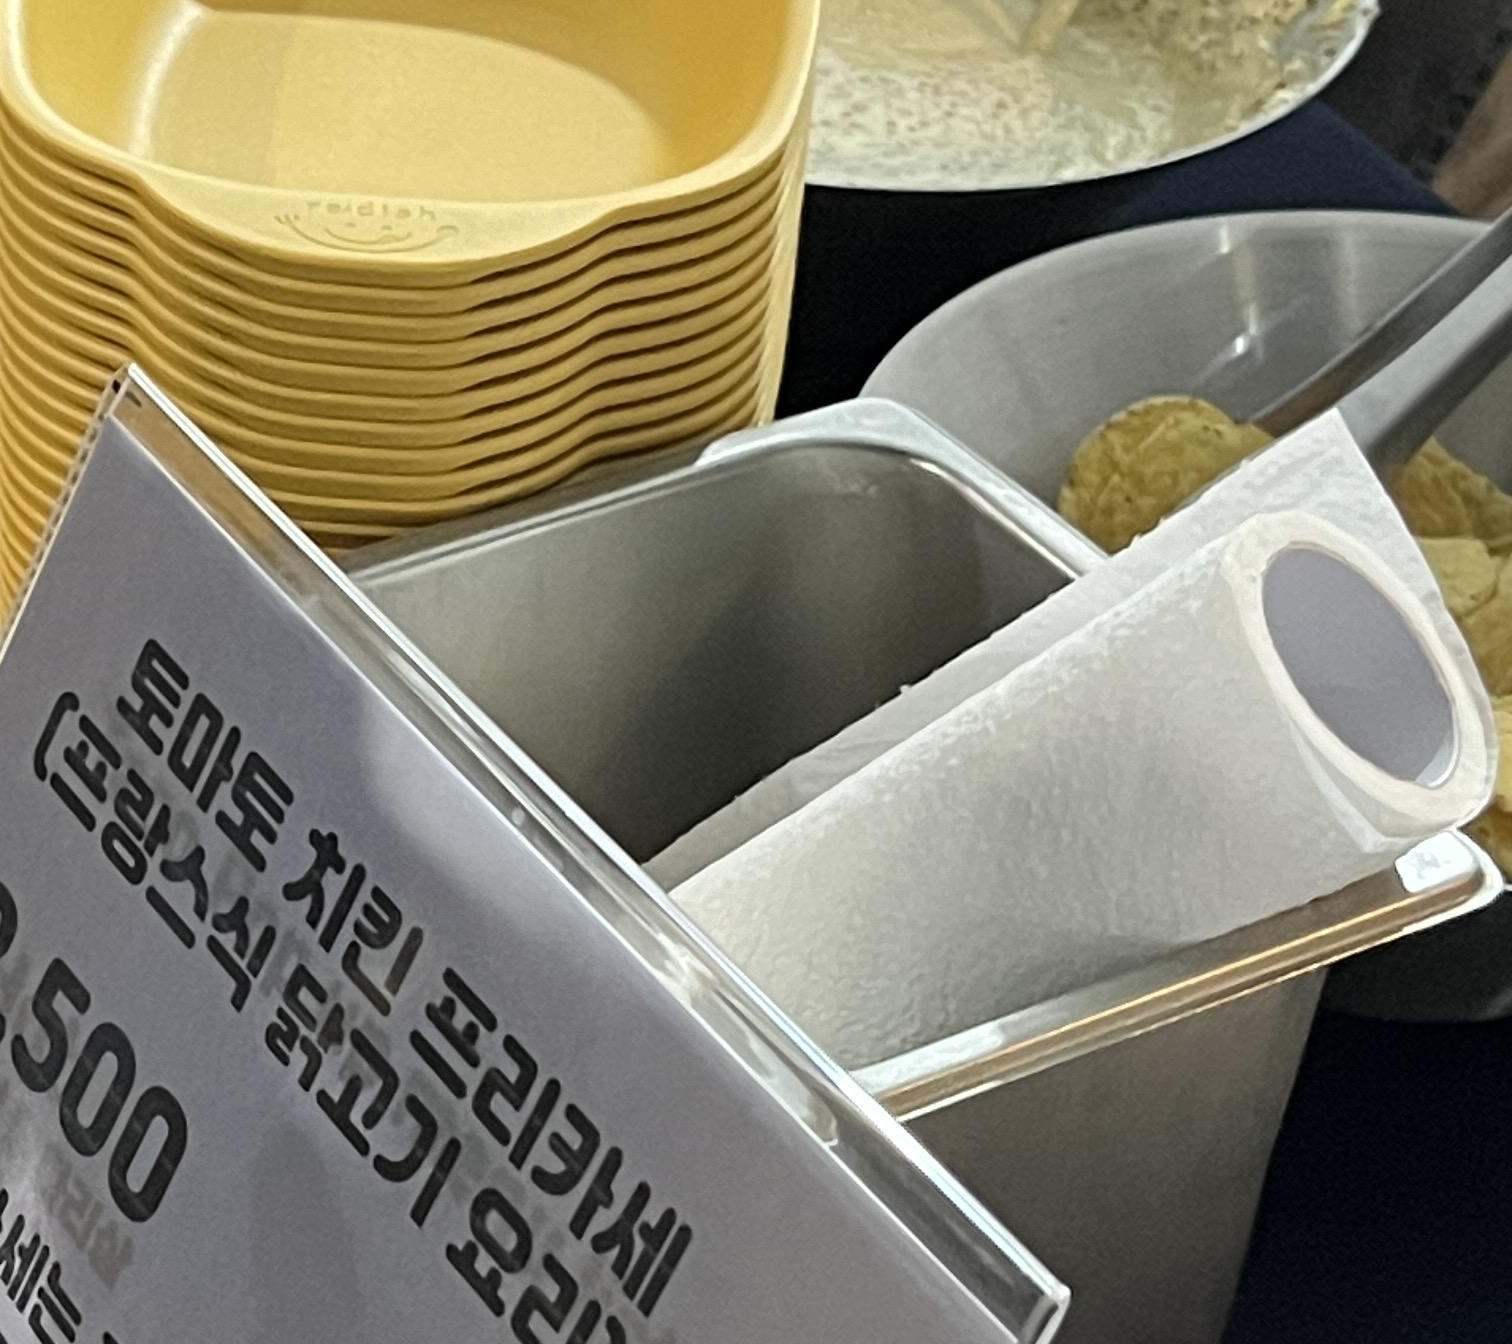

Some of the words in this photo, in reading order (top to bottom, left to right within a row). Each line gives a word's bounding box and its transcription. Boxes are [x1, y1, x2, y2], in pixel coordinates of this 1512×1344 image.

[32, 690, 277, 1014] (프랑스식
[263, 962, 462, 1229] 닭고기
[114, 637, 295, 873] 토마토
[281, 827, 424, 1017] 치킨
[408, 966, 693, 1318] 프리카세
